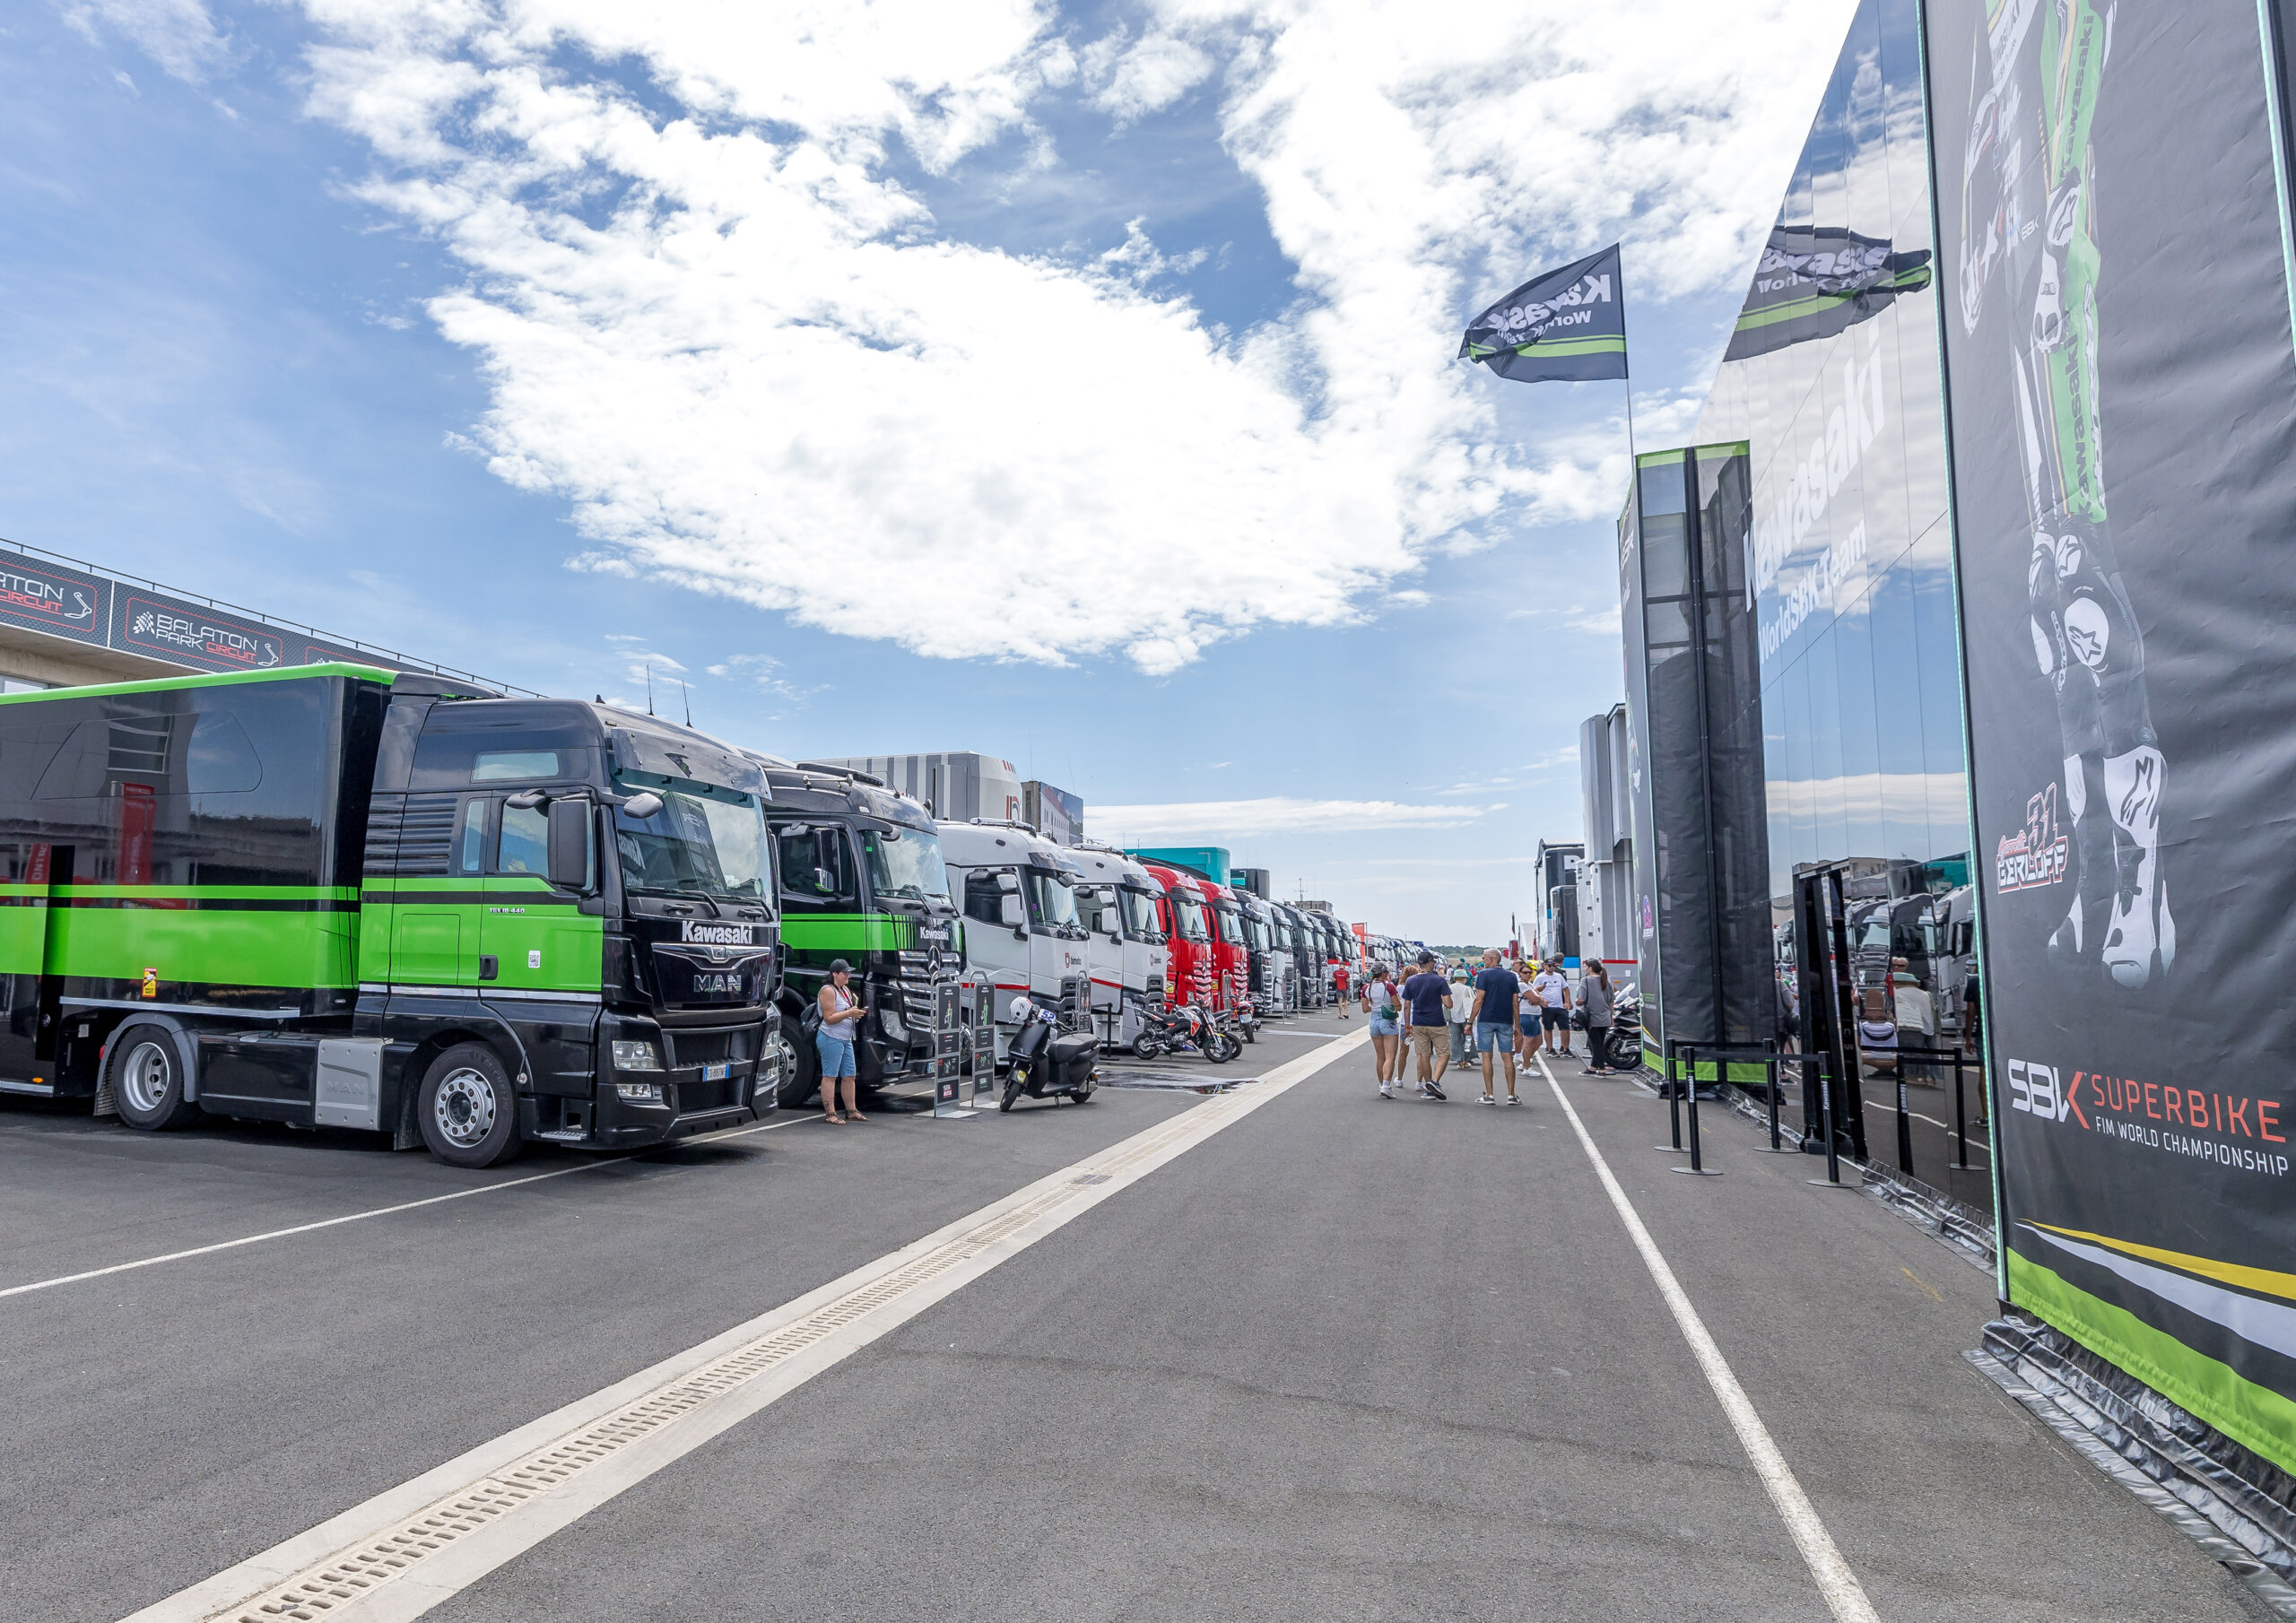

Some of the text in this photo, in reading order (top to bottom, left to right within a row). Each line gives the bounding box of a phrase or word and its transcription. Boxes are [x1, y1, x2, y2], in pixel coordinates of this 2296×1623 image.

[1744, 320, 1884, 613] Kawasaki
[1759, 518, 1868, 665] WorldSBK Team
[156, 613, 258, 654] BALATON
[156, 629, 257, 662] PARK CIRCUIT
[2027, 782, 2058, 859] 31
[1997, 844, 2066, 887] GERLOFF
[682, 920, 753, 944] Kawasaki
[919, 926, 950, 941] Kawasaki
[693, 975, 743, 994] MAN
[1040, 1010, 1056, 1023] 52
[1822, 1081, 1831, 1110] Kawasaki
[2007, 1058, 2287, 1143] SBK SUPERBIKE
[2095, 1115, 2289, 1176] FIM WORLD CHAMPIONSHIP
